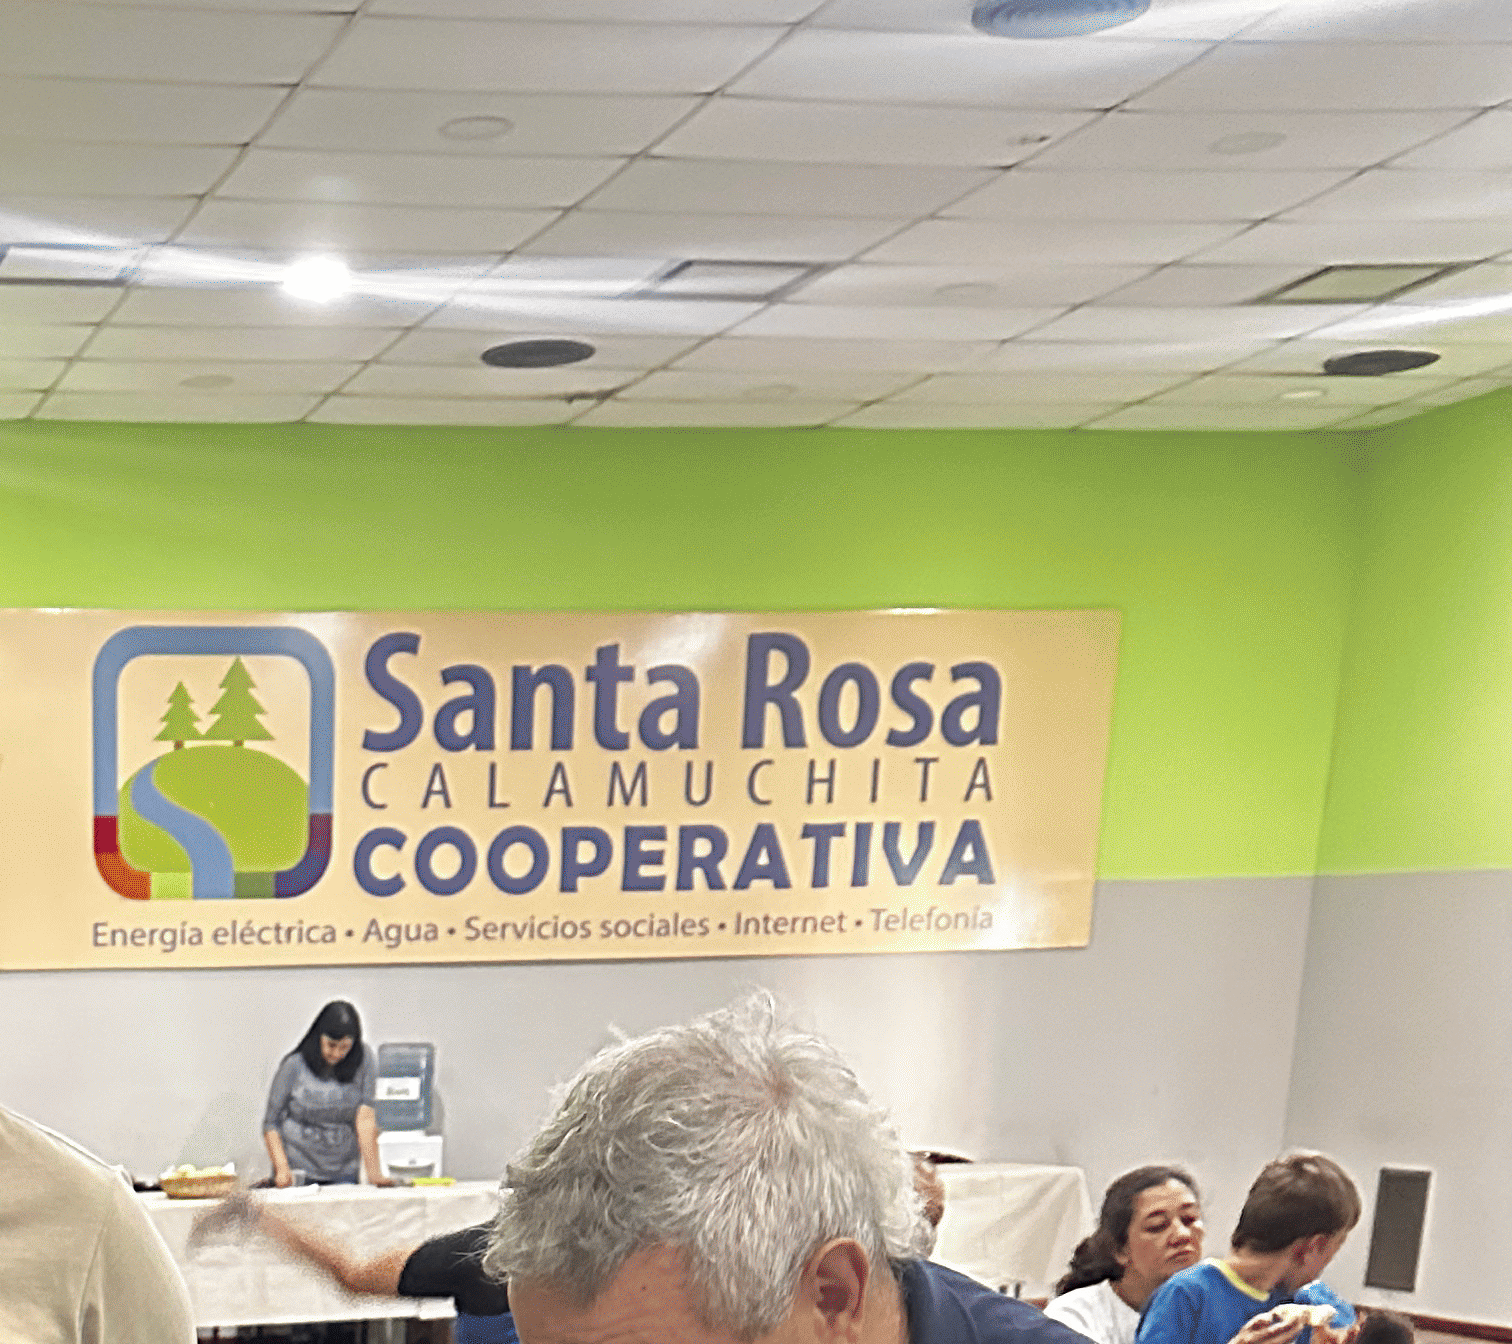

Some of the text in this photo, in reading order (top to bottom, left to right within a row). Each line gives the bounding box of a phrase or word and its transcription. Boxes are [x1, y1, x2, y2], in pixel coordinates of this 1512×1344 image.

[361, 631, 1003, 753] Santa Rosa
[361, 757, 993, 809] CALAMUCHITA
[353, 818, 997, 898] COOPERATIVA
[91, 904, 994, 953] Energía eléctrica Agua Servicios sociales Internet Telefonía
